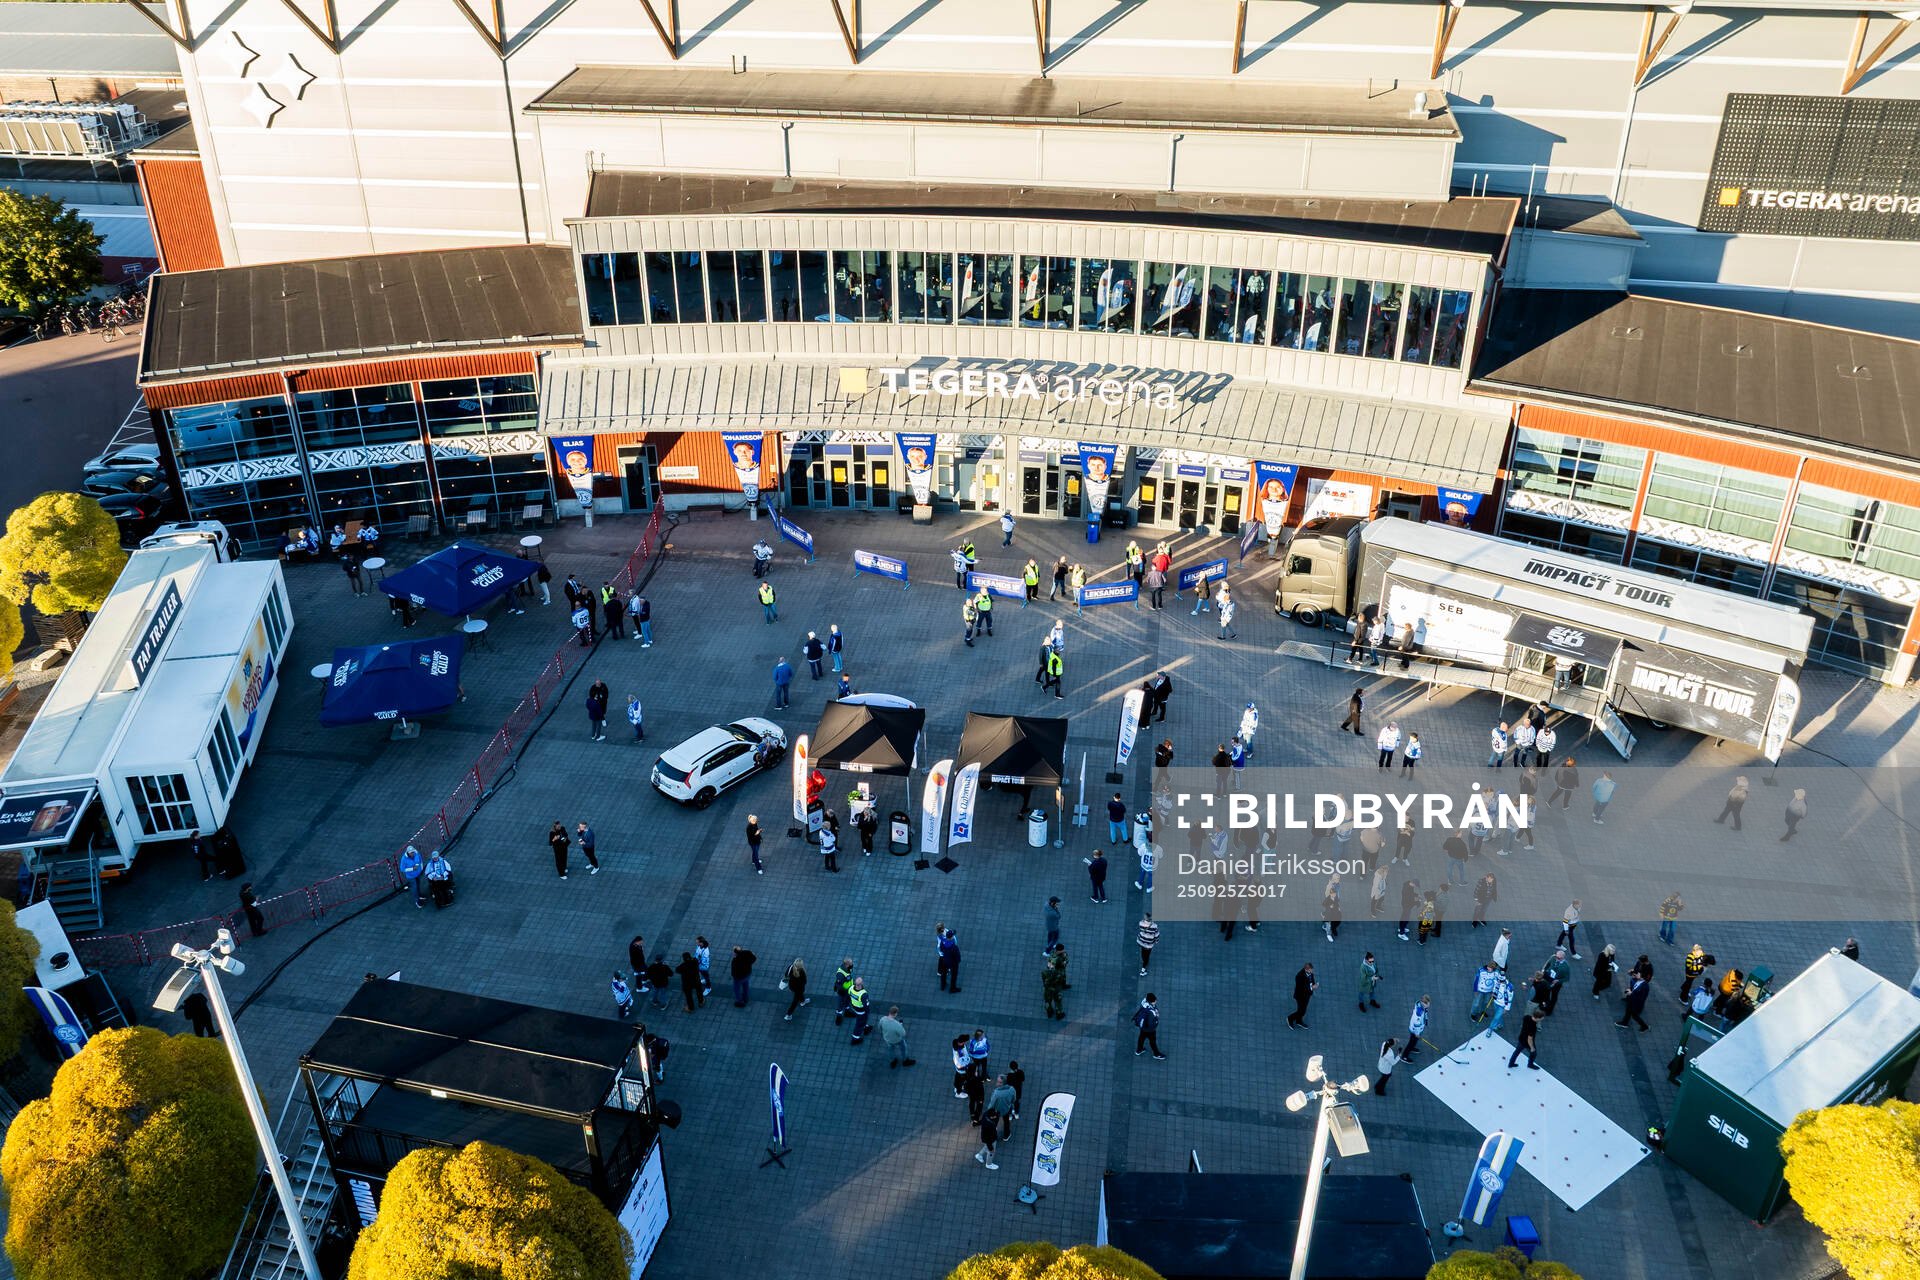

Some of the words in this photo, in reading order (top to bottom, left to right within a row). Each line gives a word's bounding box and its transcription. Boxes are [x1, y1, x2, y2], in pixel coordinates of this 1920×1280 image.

[1053, 374, 1181, 412] arena
[562, 440, 585, 448] ELIAS
[1079, 445, 1115, 454] CEHLÁRIK
[1260, 463, 1291, 474] RADOVÁ
[479, 571, 504, 588] GULD
[1523, 560, 1611, 592] IMPACT
[1613, 582, 1675, 609] TOUR
[1084, 588, 1124, 599] LEKSANDS
[1125, 586, 1133, 596] IF
[1439, 602, 1464, 615] SEB
[136, 641, 153, 673] TAP
[149, 592, 178, 648] TRAILER
[437, 654, 449, 675] GULD
[1630, 666, 1704, 703] IMPACT
[1703, 685, 1755, 717] TOUR
